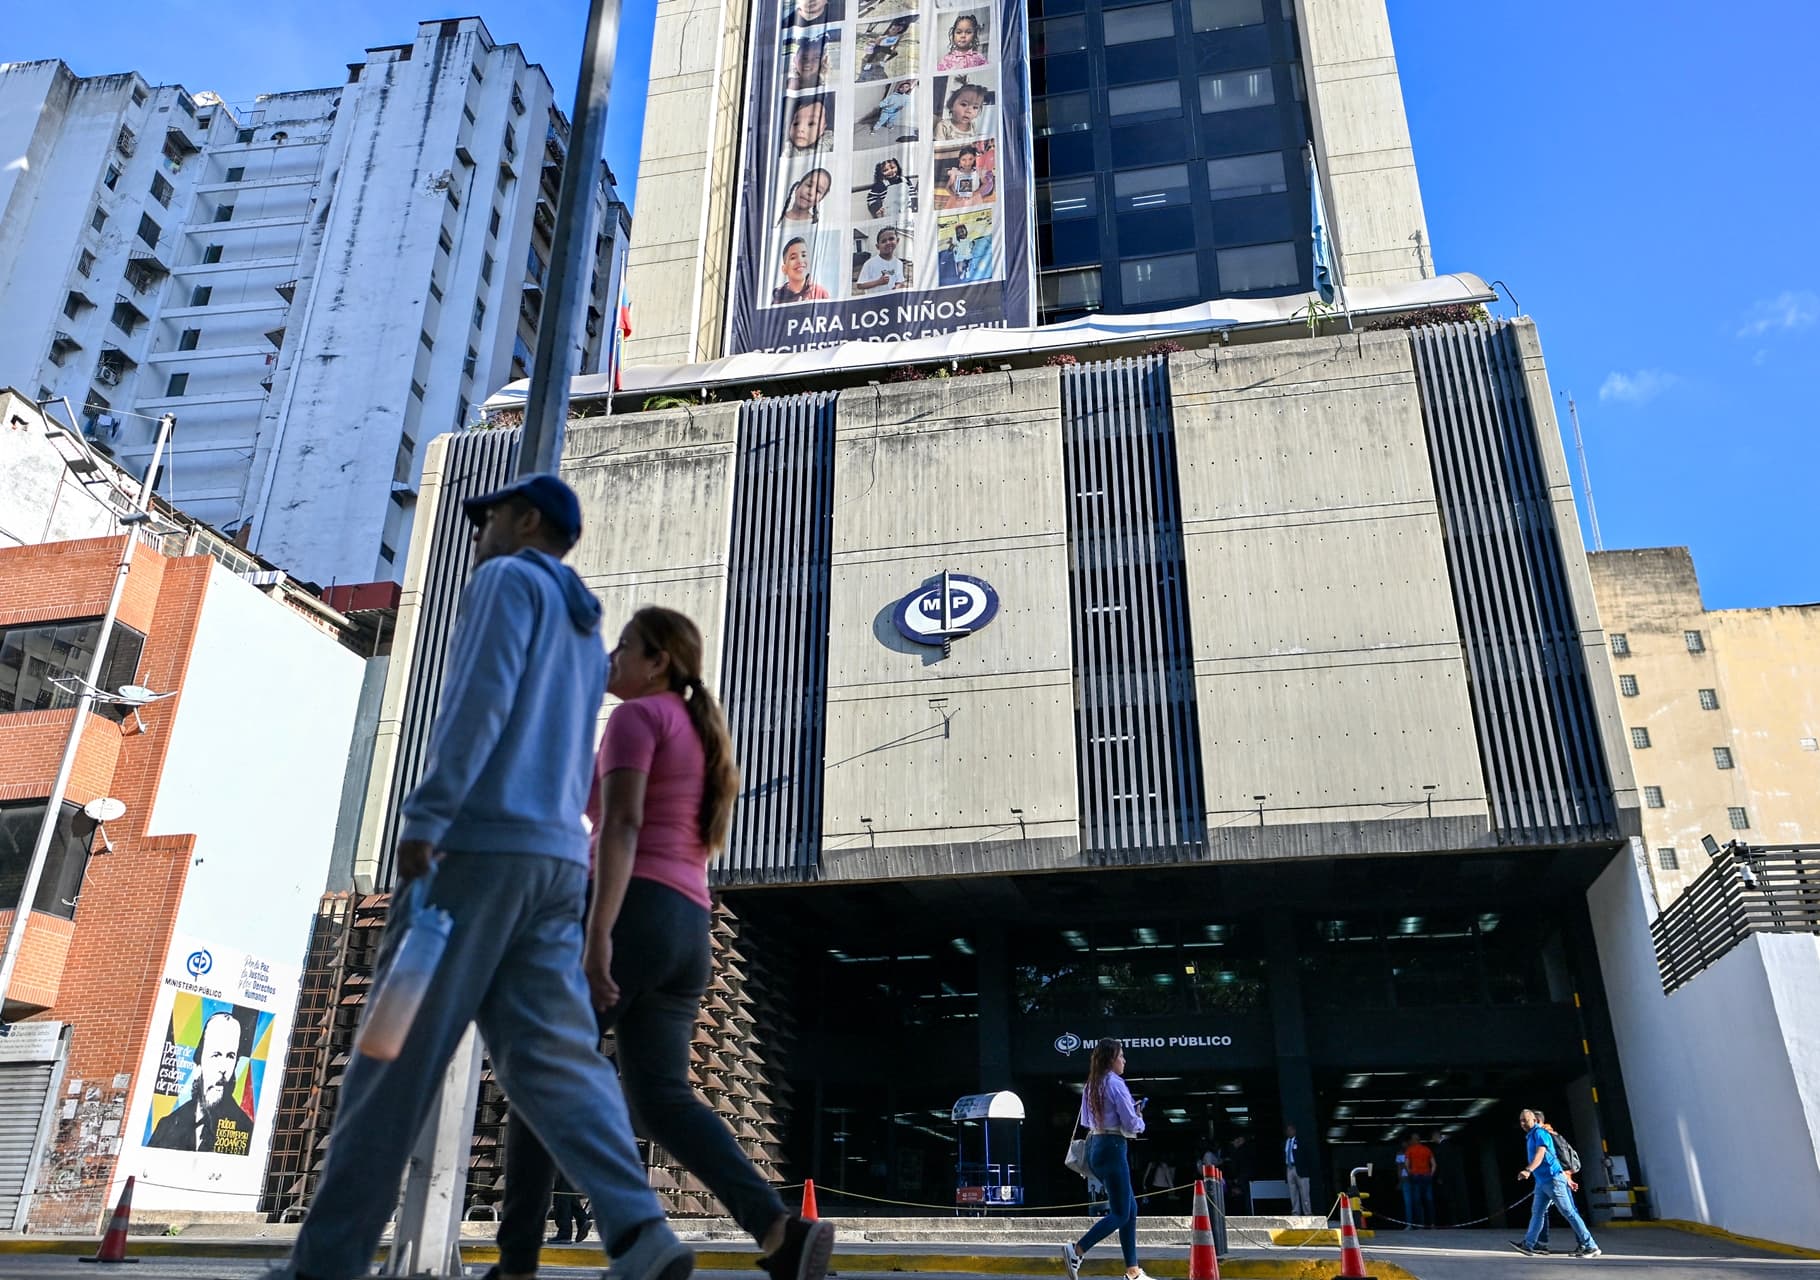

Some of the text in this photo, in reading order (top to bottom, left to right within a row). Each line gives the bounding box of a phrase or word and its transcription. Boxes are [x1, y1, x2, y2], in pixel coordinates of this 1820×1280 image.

[787, 299, 967, 336] PARA LOS NIÑOS
[165, 977, 222, 998] MINISTERIO PÚBLICO
[1083, 1037, 1165, 1049] MITERIO
[1169, 1034, 1232, 1047] PÚBLICO
